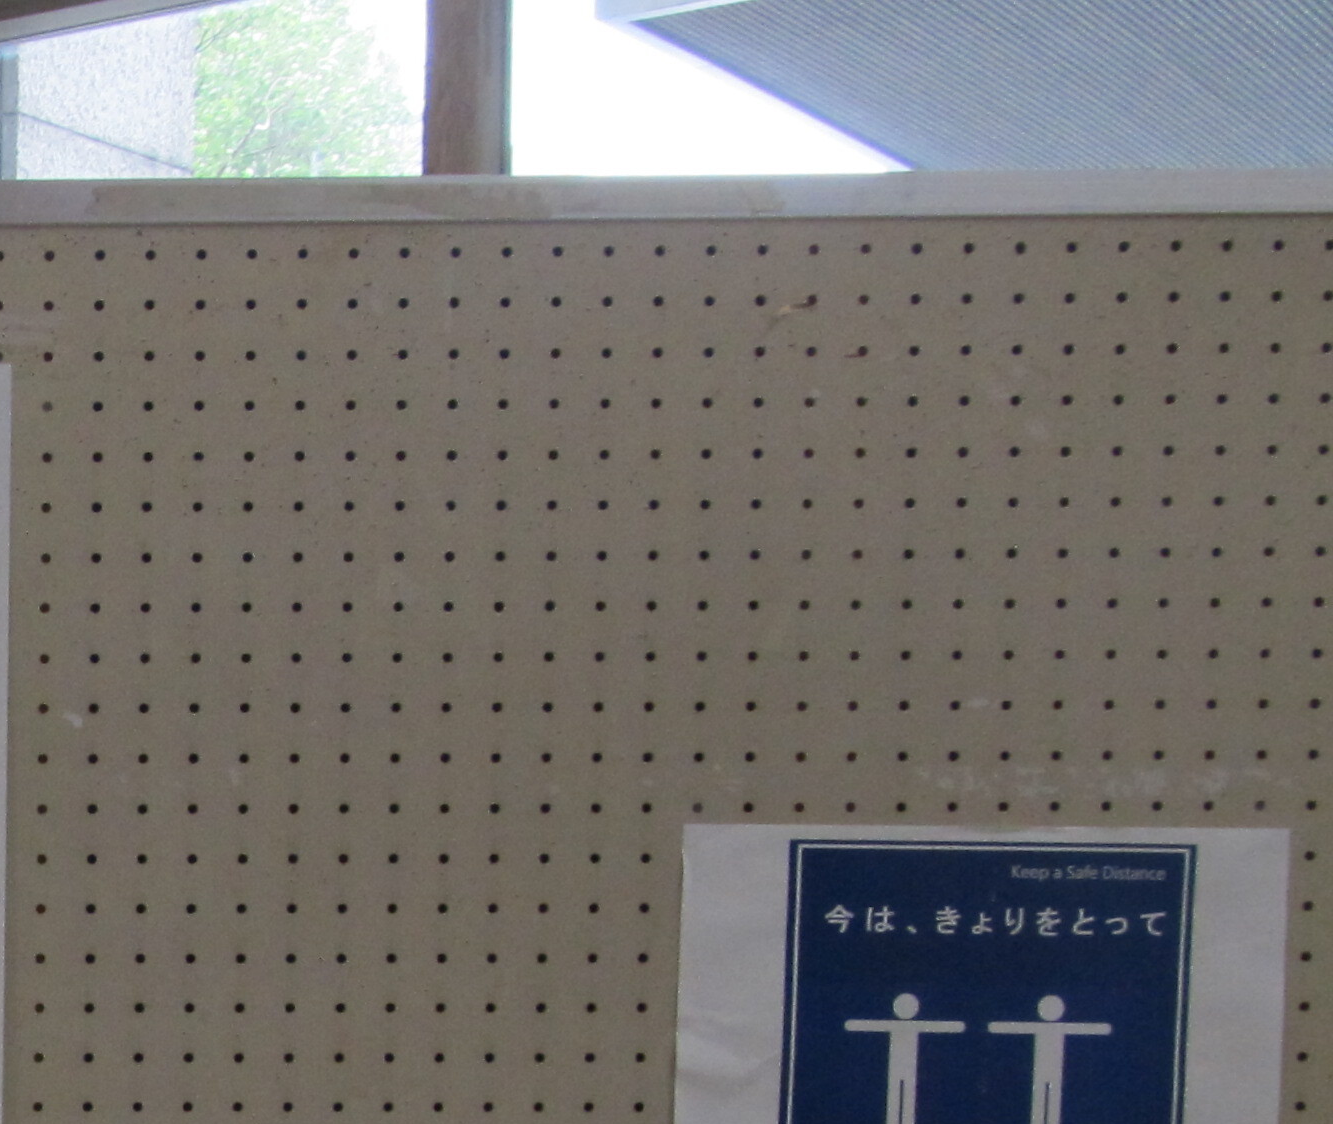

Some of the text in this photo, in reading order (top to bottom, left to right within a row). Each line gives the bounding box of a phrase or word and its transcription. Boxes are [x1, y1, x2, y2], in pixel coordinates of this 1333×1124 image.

[1011, 865, 1167, 881] Keep a Safe Distance
[824, 904, 1167, 936] 今は、きょりをとって
